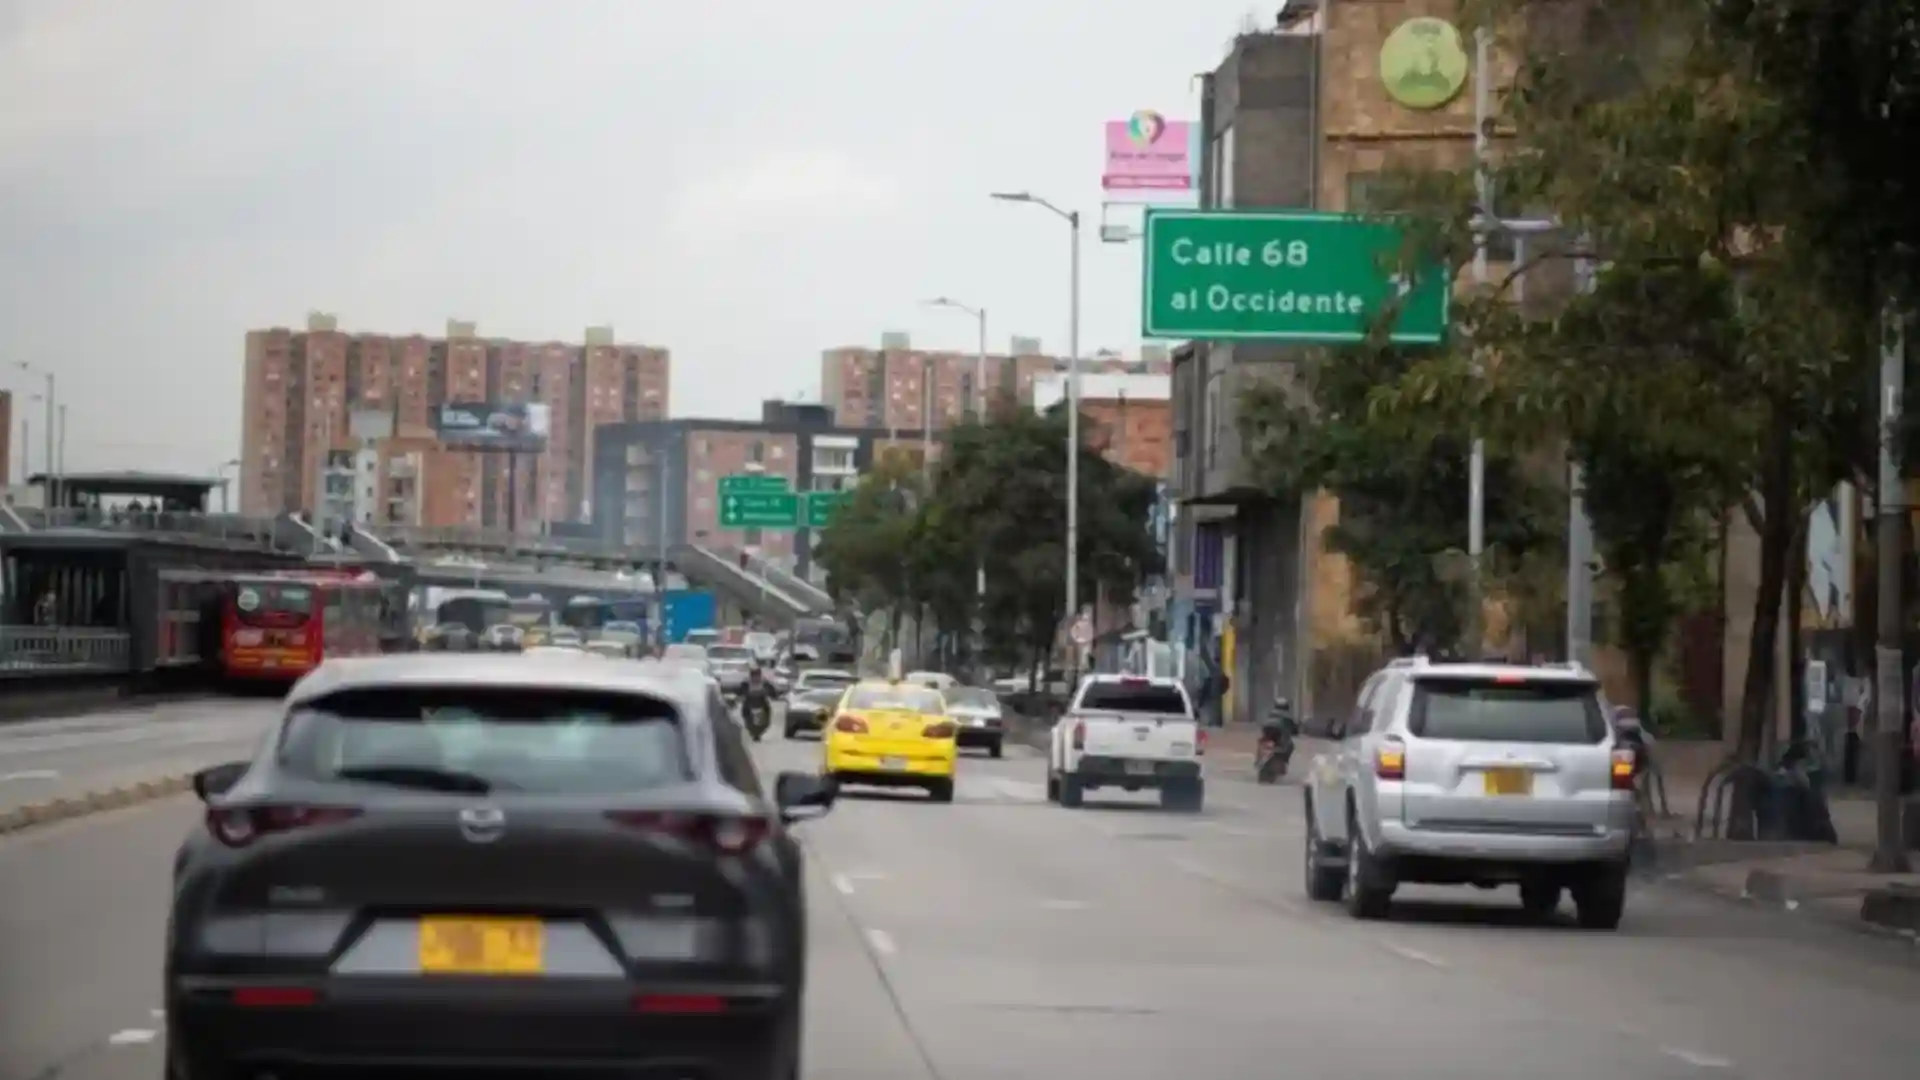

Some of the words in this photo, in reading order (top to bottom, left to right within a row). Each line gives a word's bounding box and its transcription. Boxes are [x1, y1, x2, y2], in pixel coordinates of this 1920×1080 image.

[1171, 237, 1251, 266] Calle
[1261, 239, 1309, 267] 68
[1171, 287, 1198, 311] al
[1207, 284, 1364, 313] Occidente
